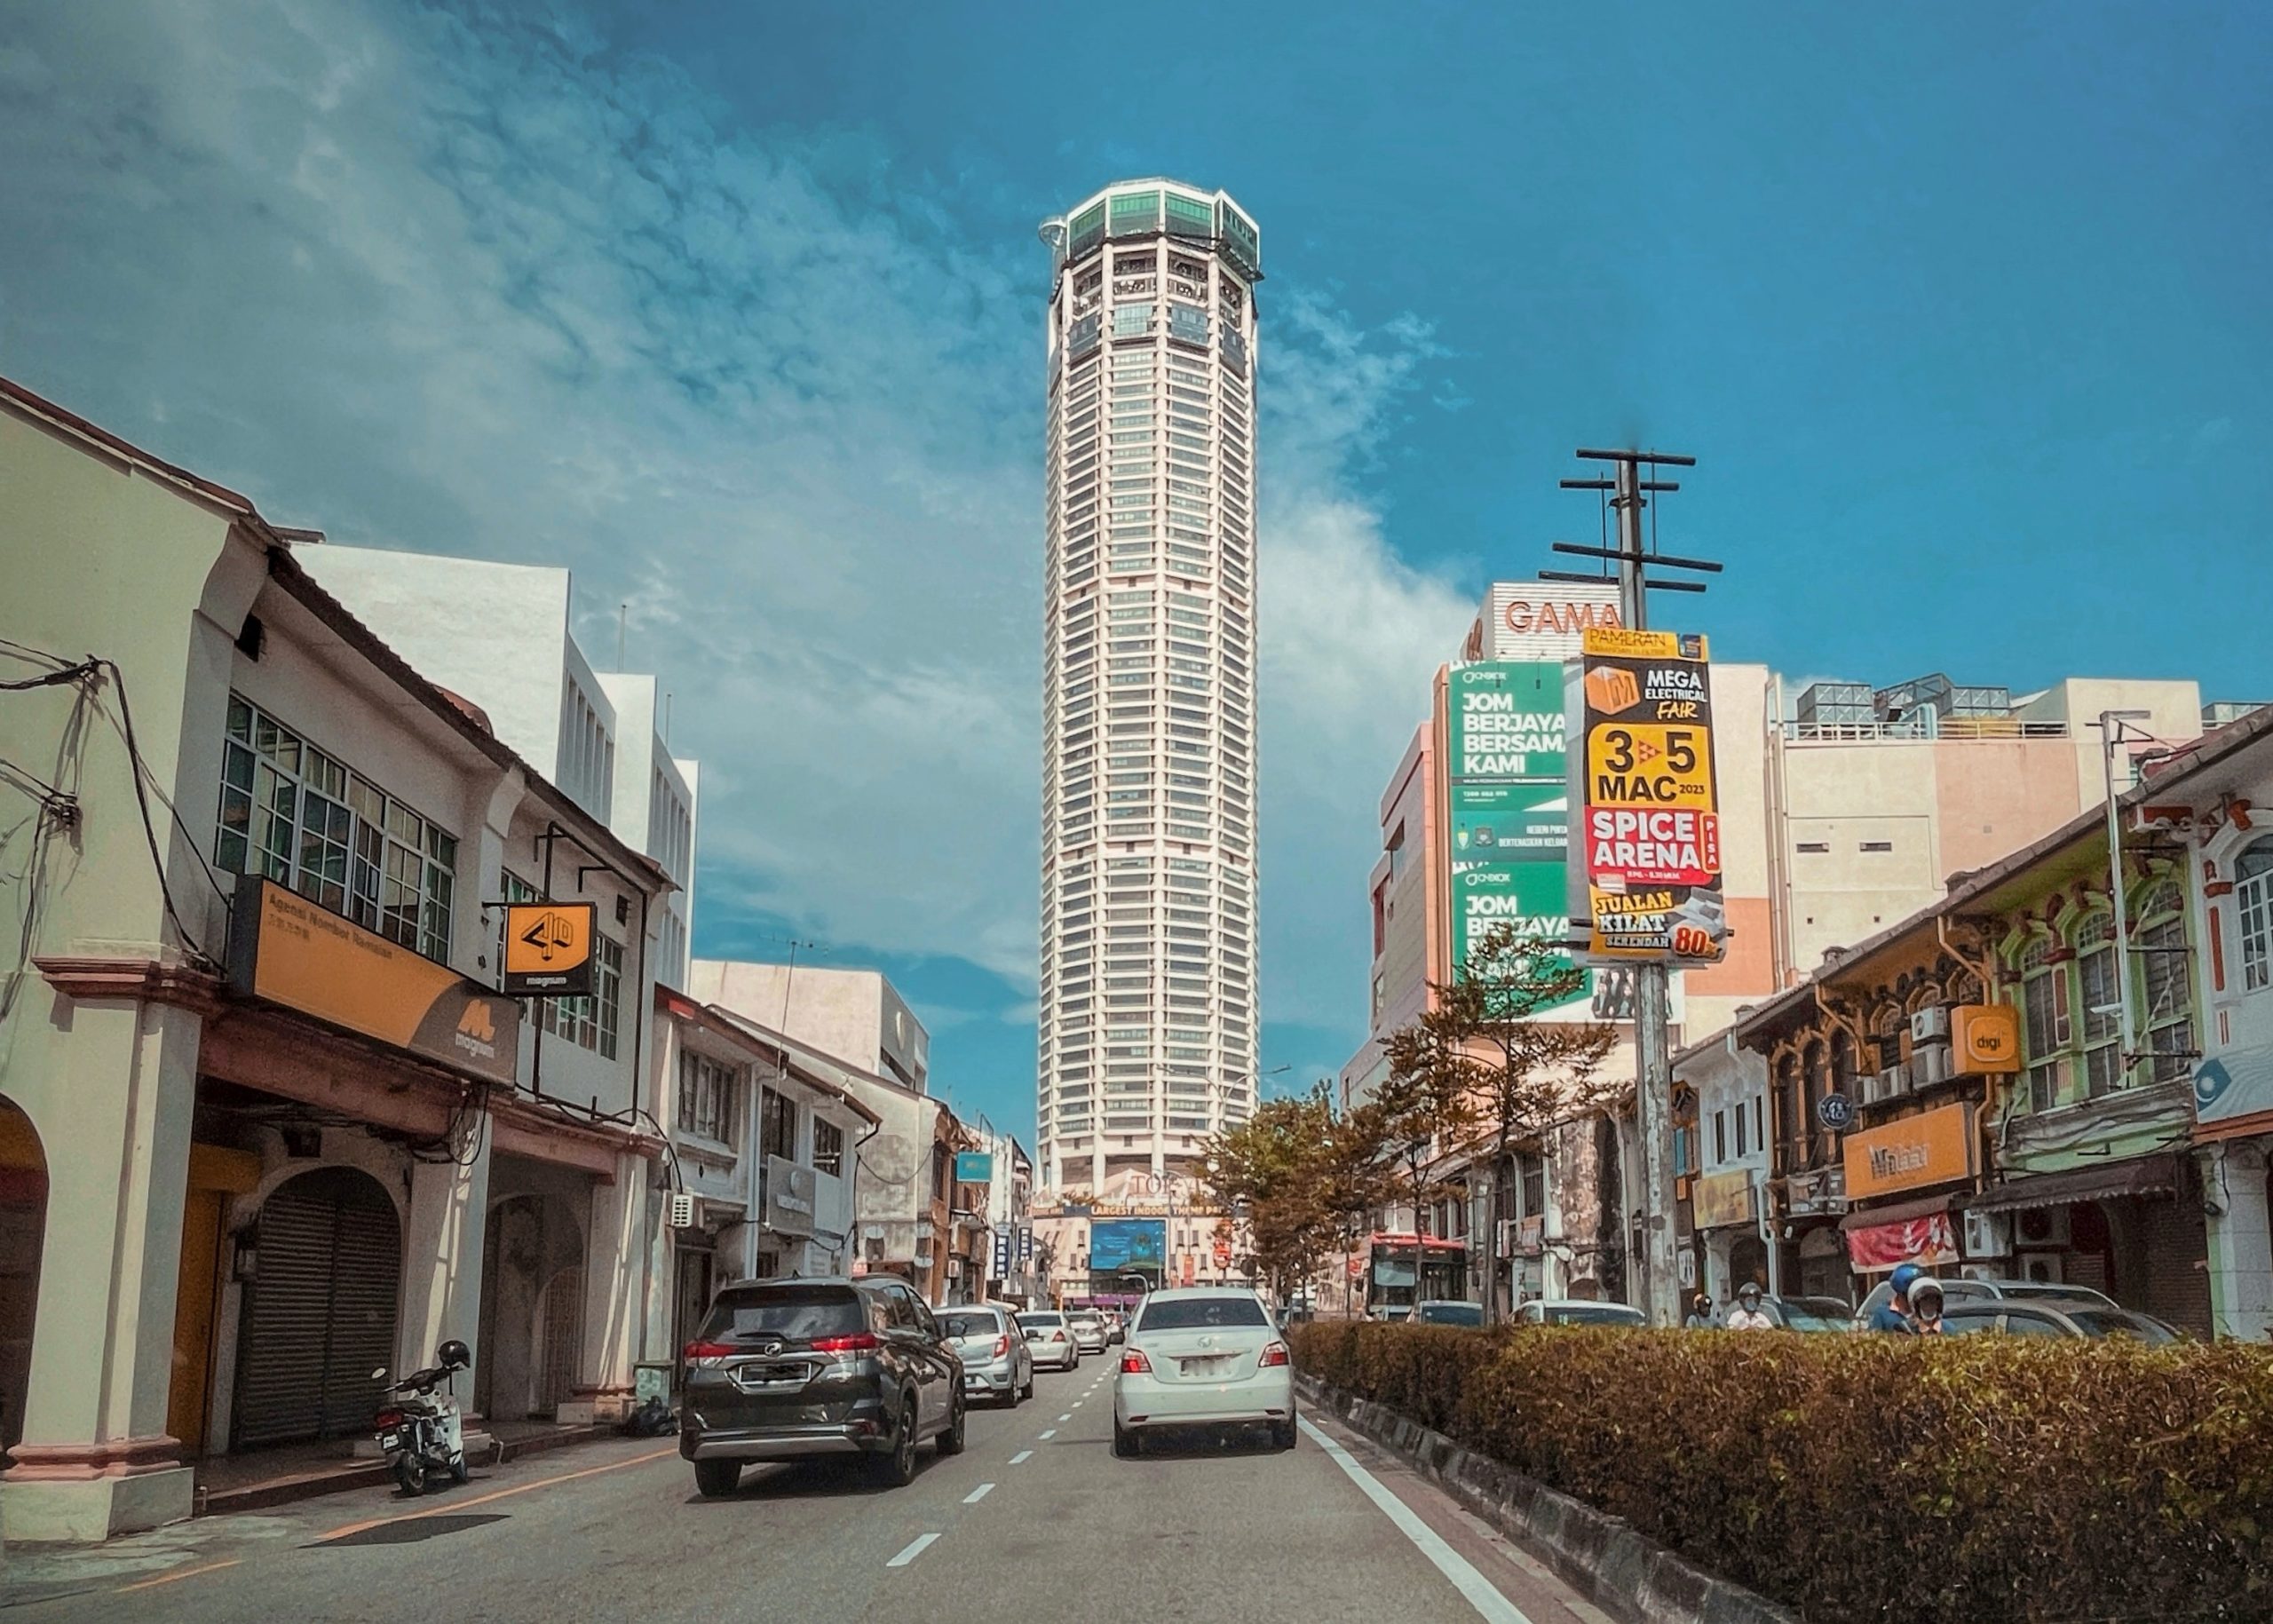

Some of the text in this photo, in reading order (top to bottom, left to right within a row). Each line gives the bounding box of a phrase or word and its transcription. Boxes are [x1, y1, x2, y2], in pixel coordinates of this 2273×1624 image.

[1506, 601, 1624, 633] GAMA
[1590, 630, 1666, 646] PAMERAN
[1647, 669, 1703, 689] MEGA
[1462, 693, 1513, 712] JOM
[1644, 688, 1707, 702] ELECTRICAL
[1657, 701, 1698, 720] FAIR
[1463, 713, 1565, 733] BERJAYA
[1463, 734, 1565, 753] BERSAM
[1605, 730, 1696, 774] 3 5
[1463, 755, 1525, 773] KAMI
[1598, 775, 1705, 802] MAC 2023
[1593, 811, 1695, 842] SPICE
[1706, 820, 1717, 865] PISA
[1593, 842, 1701, 869] ARENA
[1465, 895, 1517, 915] JOM
[1597, 891, 1674, 914] JUALAN
[1598, 914, 1666, 932] KILAT
[1606, 937, 1670, 947] SERENDAH
[527, 977, 566, 987] magnum
[1091, 1205, 1132, 1216] LARGEST
